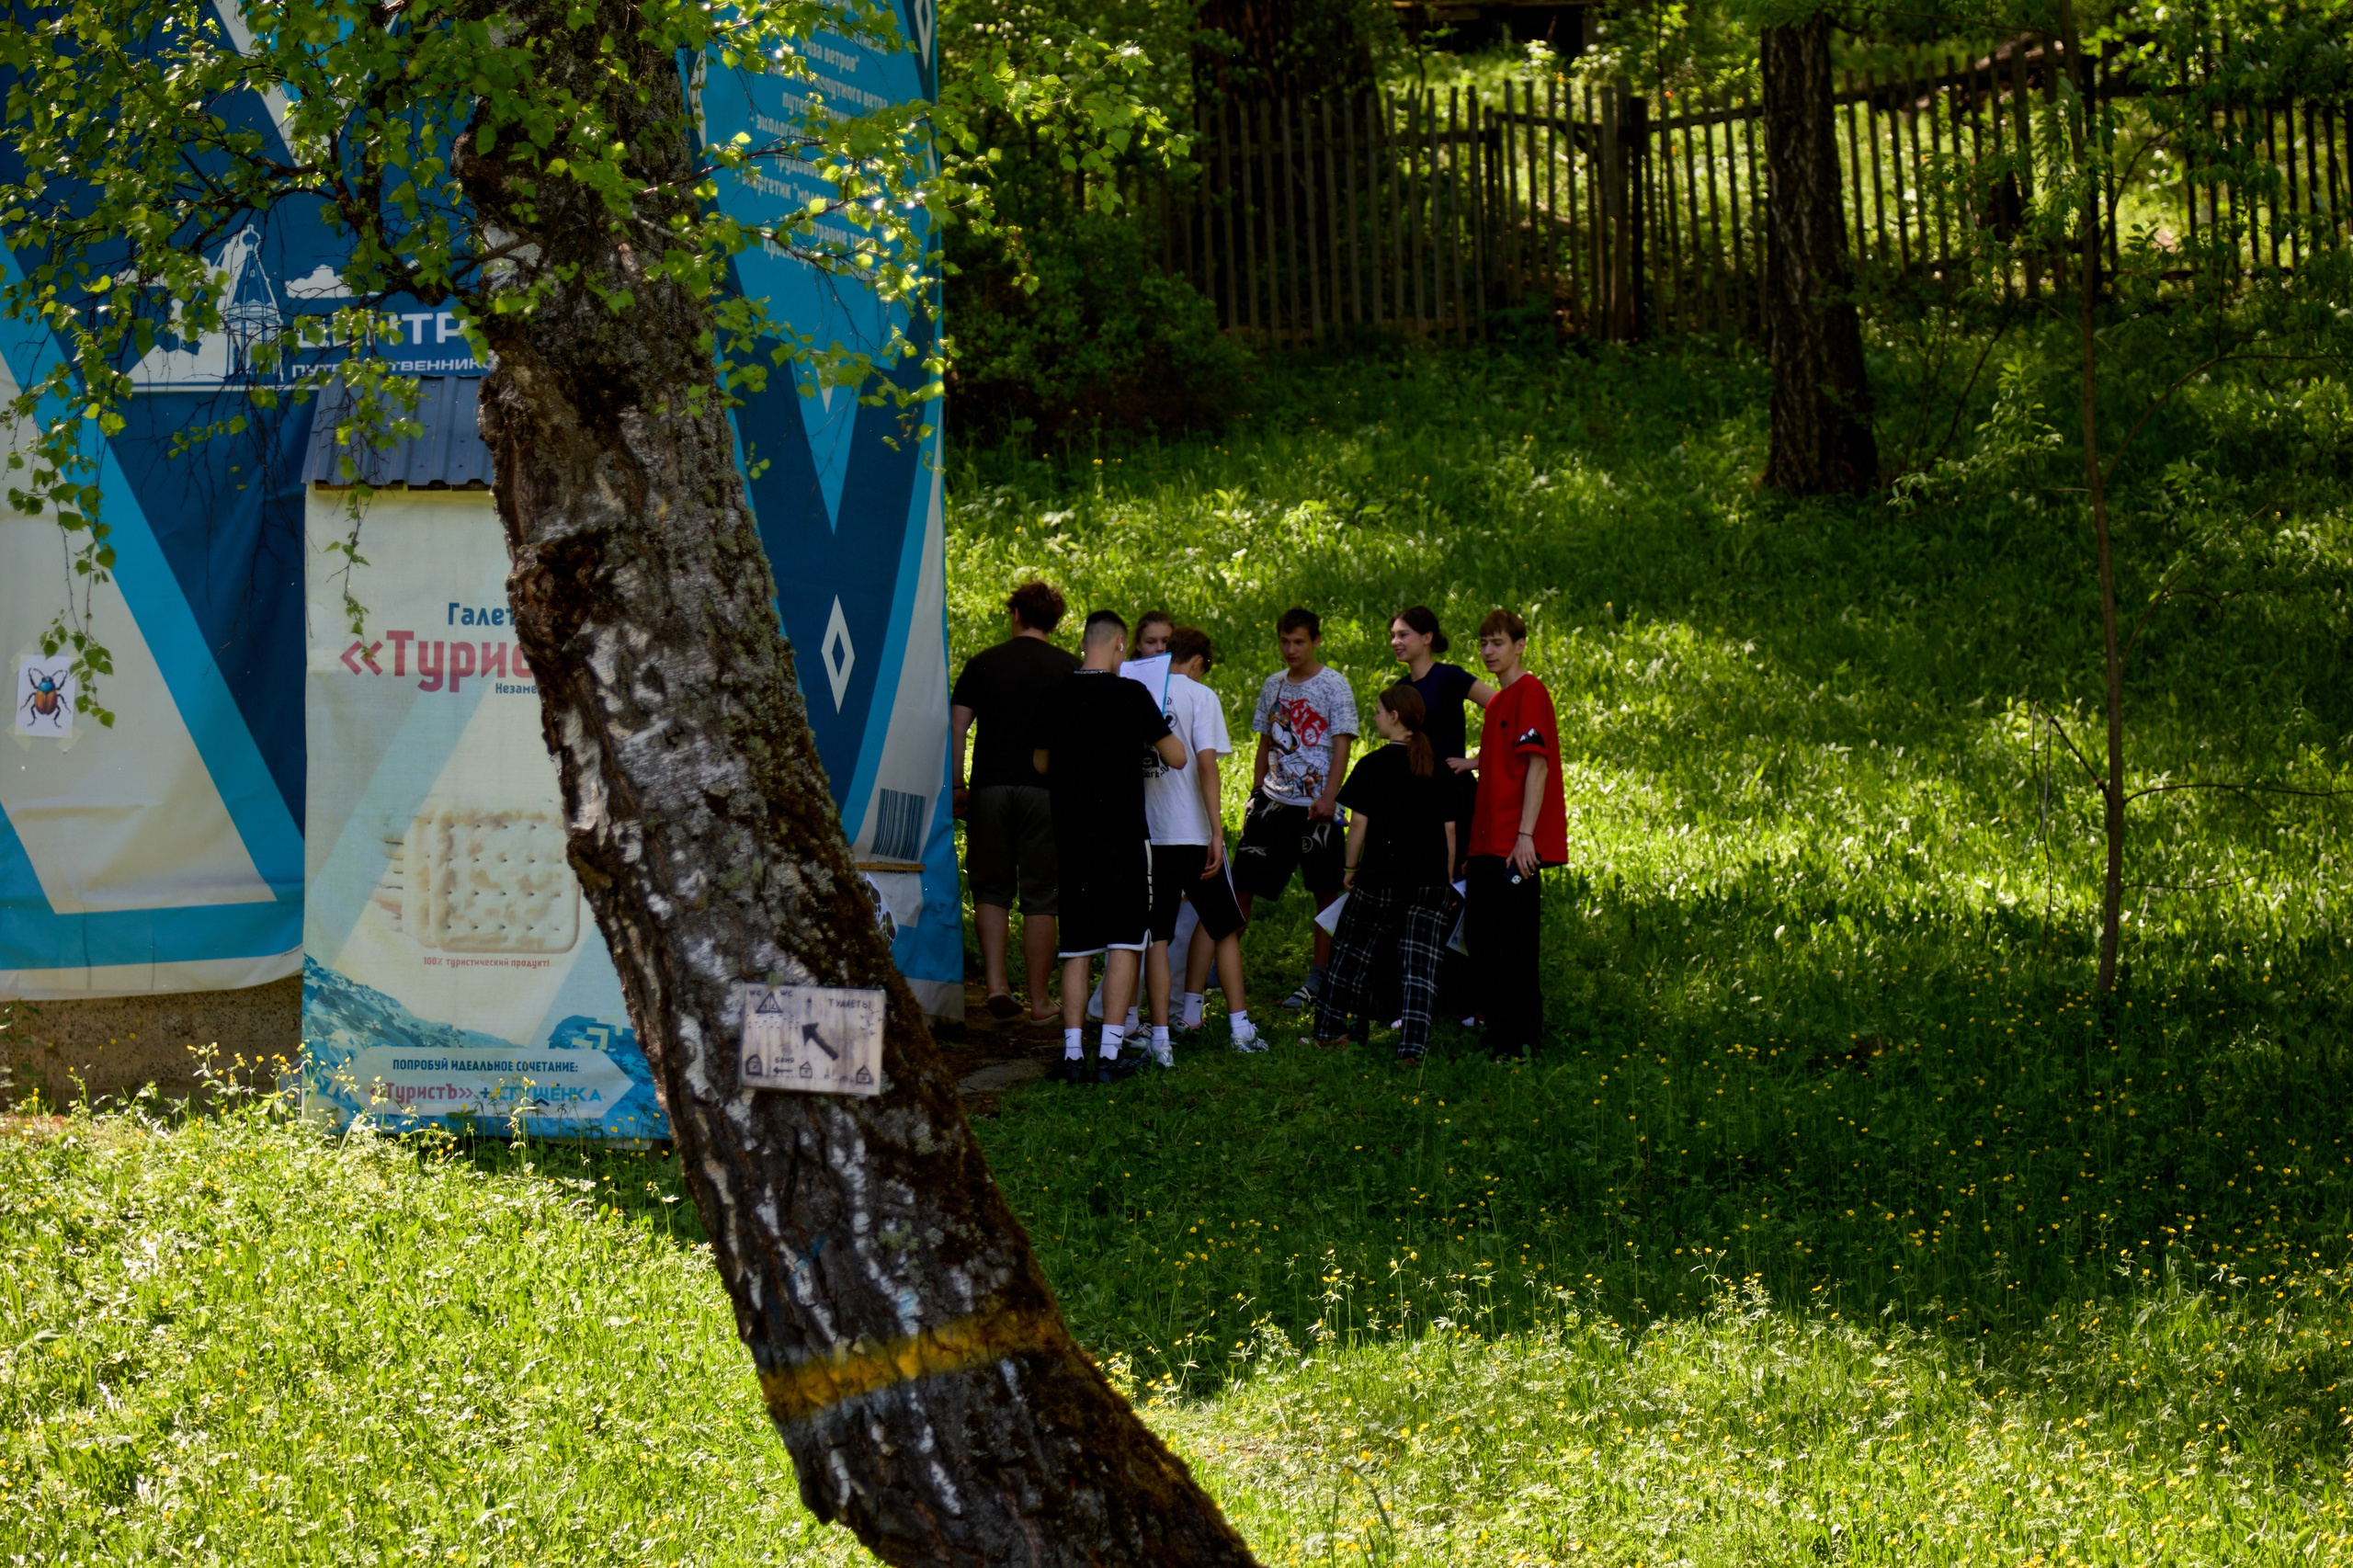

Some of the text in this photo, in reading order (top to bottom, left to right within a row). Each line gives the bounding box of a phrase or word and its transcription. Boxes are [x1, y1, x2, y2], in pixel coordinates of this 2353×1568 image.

[423, 956, 551, 969] 100% туристический продукт!
[392, 1058, 578, 1073] ПОПРОБУЙ ИДЕАЛЬНОЕ СОЧЕТАНИЕ:
